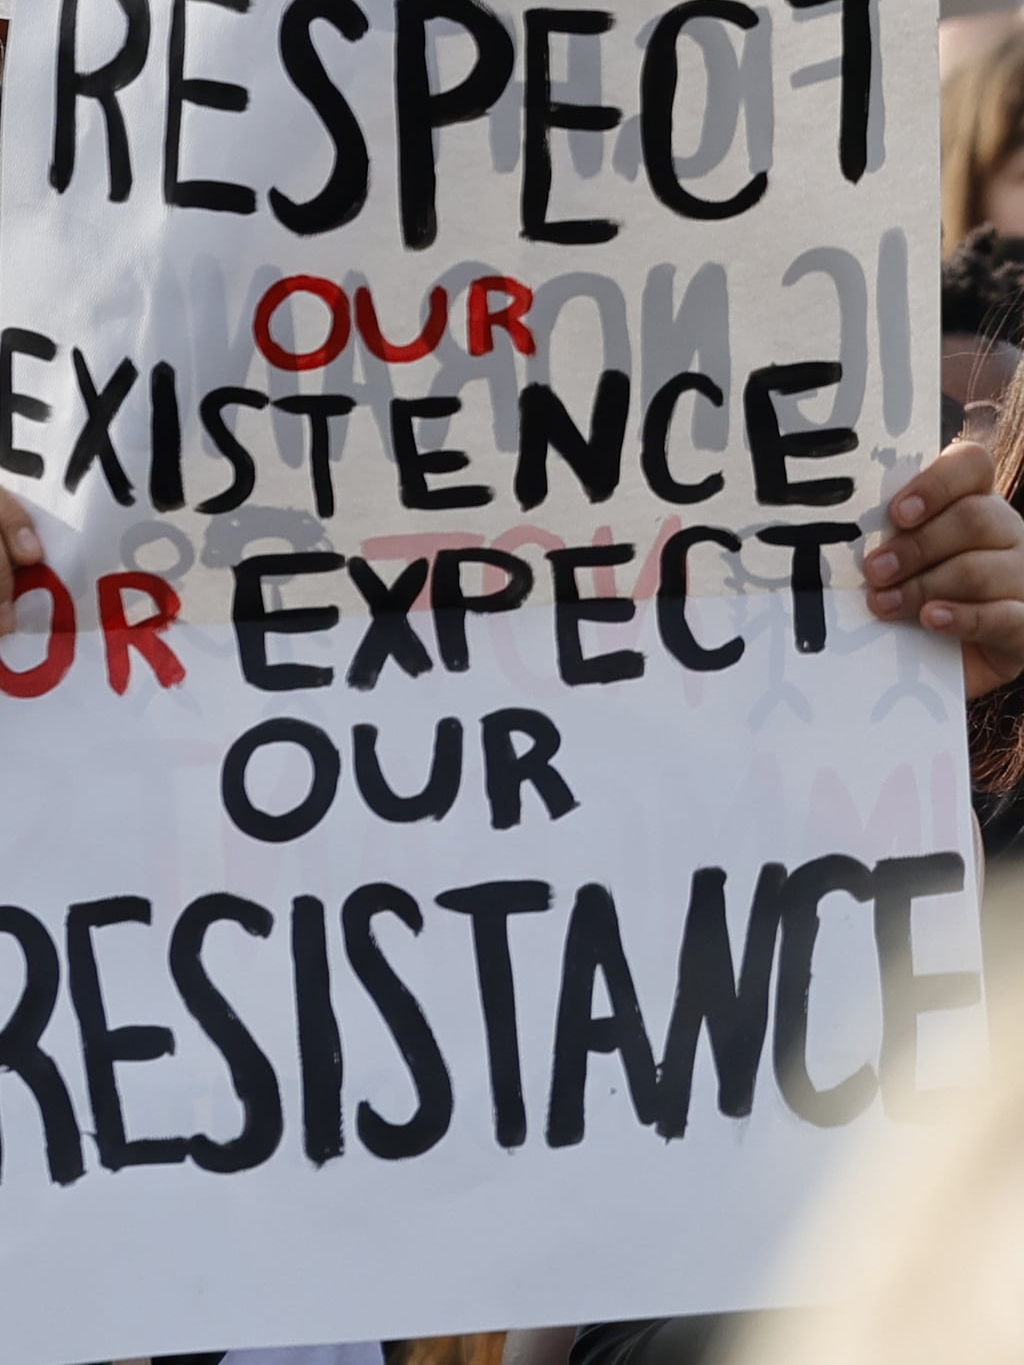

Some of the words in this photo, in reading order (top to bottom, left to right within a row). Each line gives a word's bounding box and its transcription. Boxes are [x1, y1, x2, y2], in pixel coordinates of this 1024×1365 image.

[253, 275, 537, 371] OUR
[0, 326, 859, 518] EXISTENCE
[0, 560, 187, 699] OR
[232, 521, 864, 691] EXPECT
[221, 707, 581, 843] OUR
[0, 852, 983, 1186] RESISTANCE
